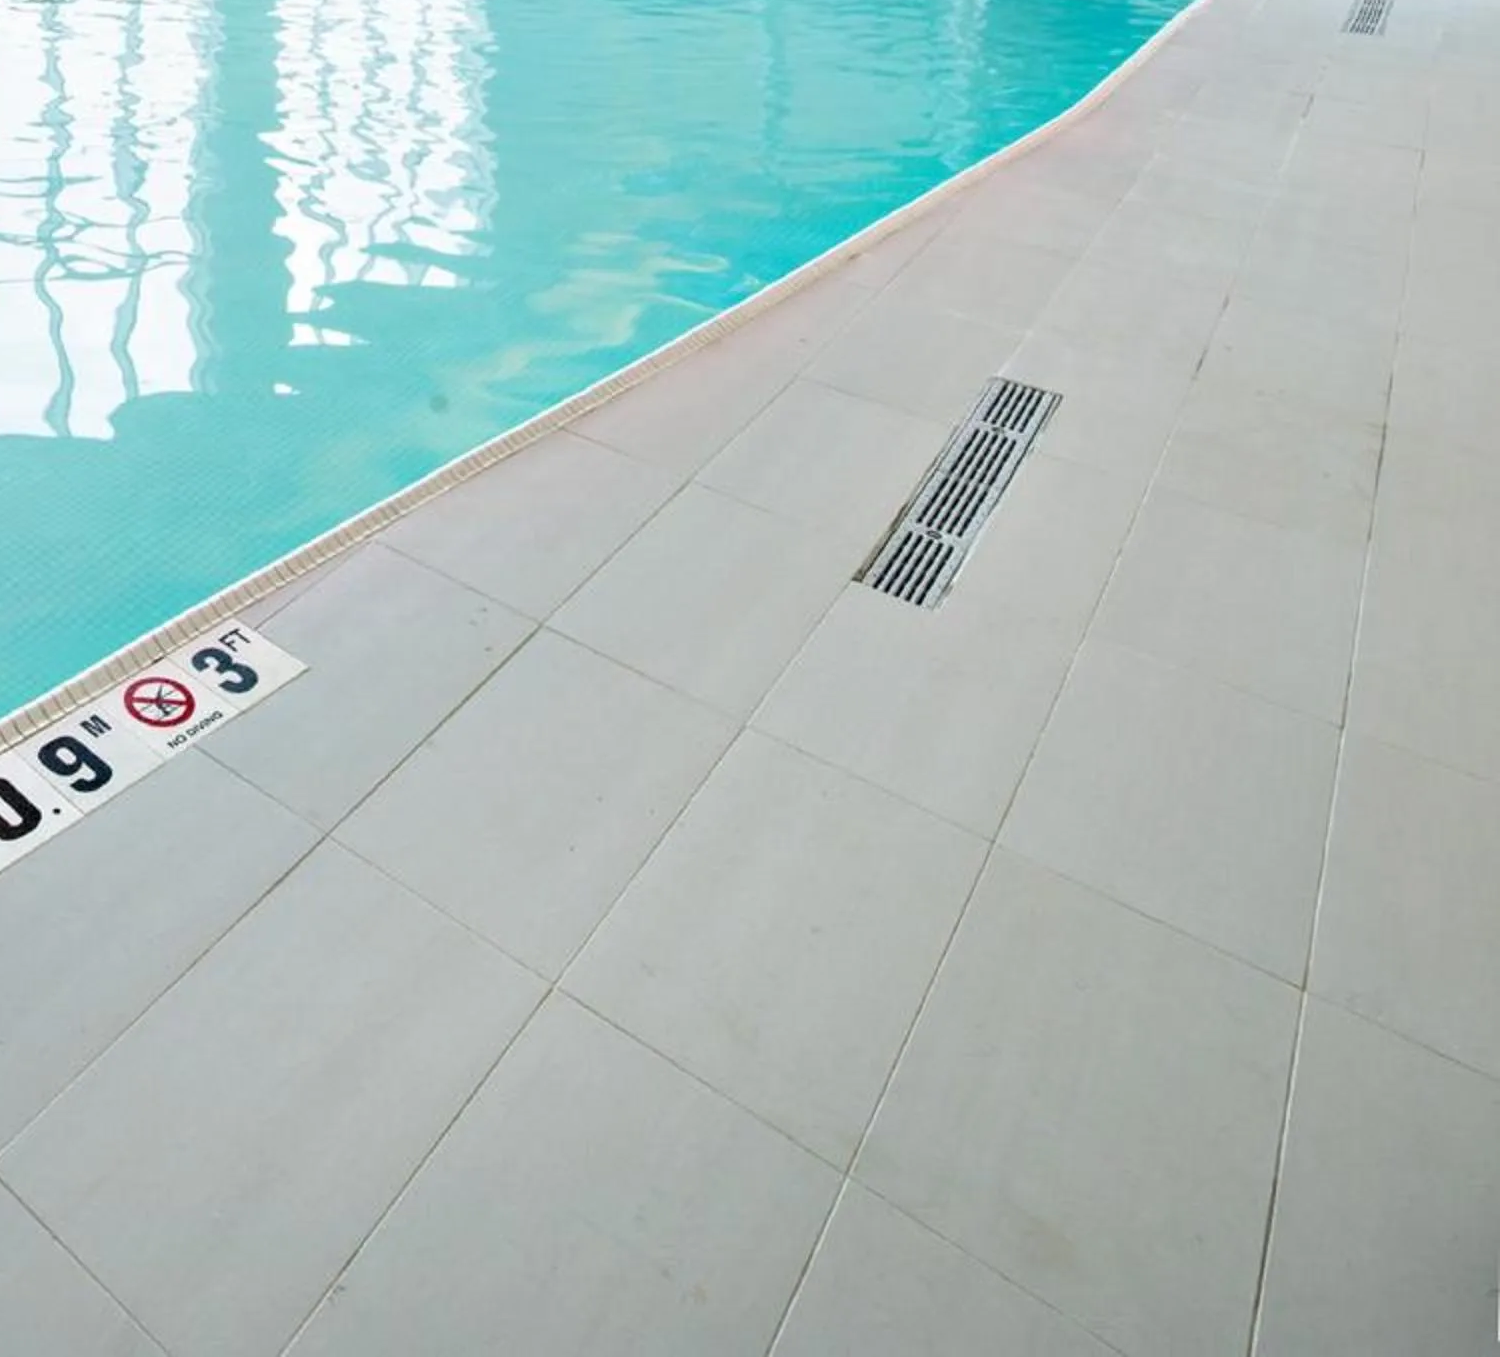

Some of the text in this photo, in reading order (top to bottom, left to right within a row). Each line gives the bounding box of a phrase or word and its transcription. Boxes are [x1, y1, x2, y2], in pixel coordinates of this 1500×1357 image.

[218, 628, 251, 652] FT
[190, 647, 258, 694] 3
[167, 710, 223, 748] NO DIVING
